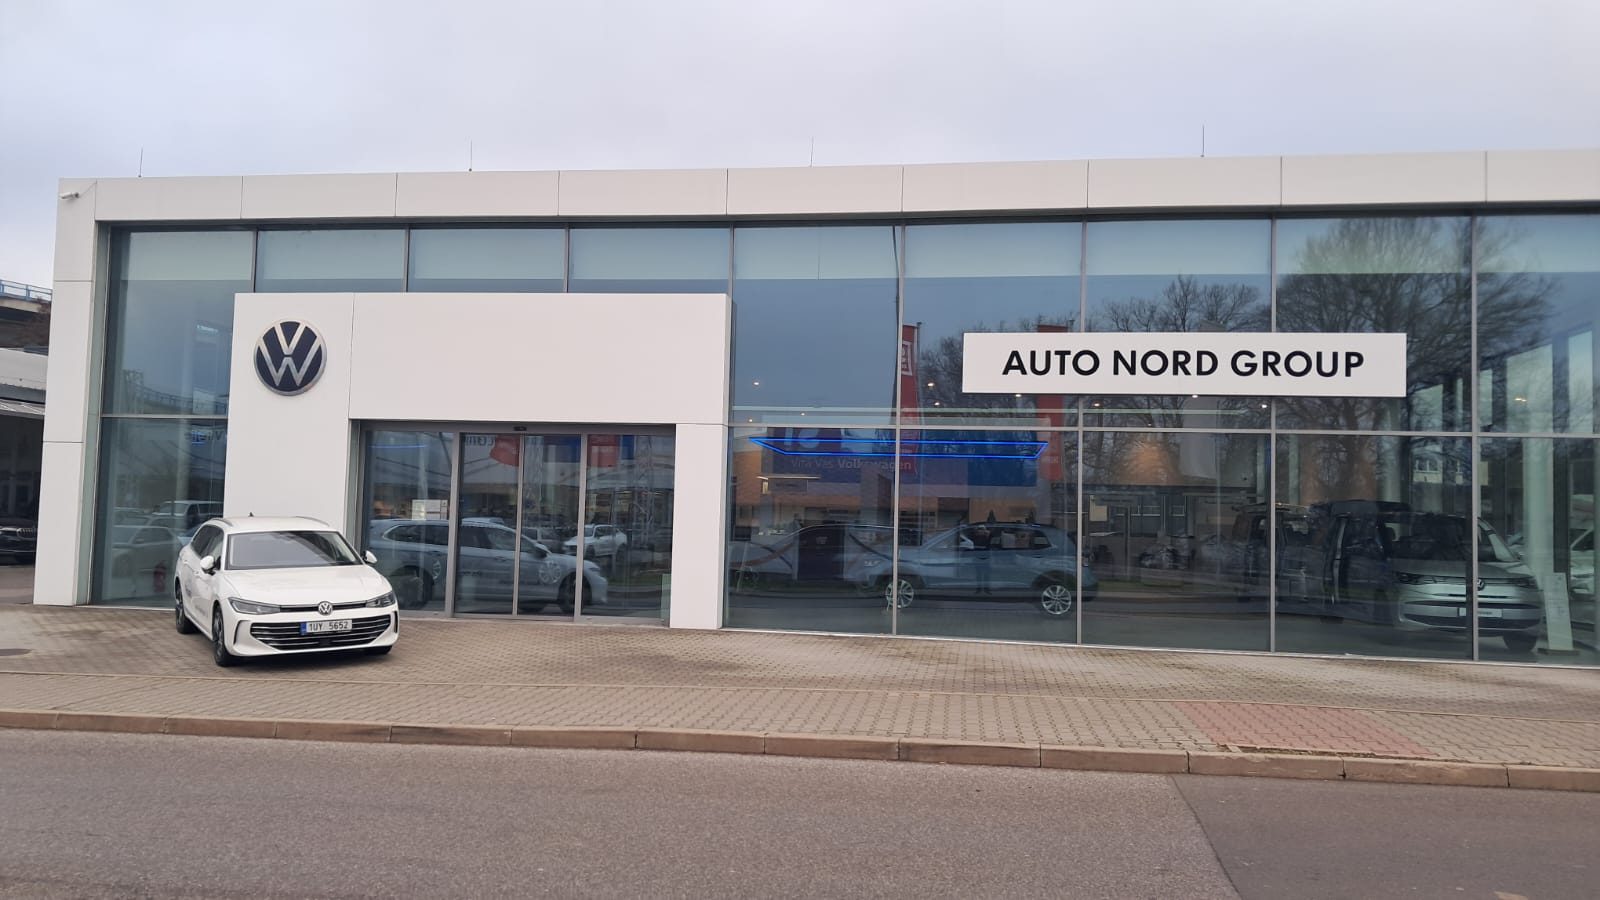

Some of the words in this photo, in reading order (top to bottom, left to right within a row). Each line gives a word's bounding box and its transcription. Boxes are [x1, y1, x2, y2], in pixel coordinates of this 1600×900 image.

[1002, 349, 1100, 376] AUTO
[1113, 349, 1219, 376] NORD
[1230, 350, 1364, 378] GROUP
[308, 622, 323, 631] 1UY
[328, 620, 349, 630] 5652
